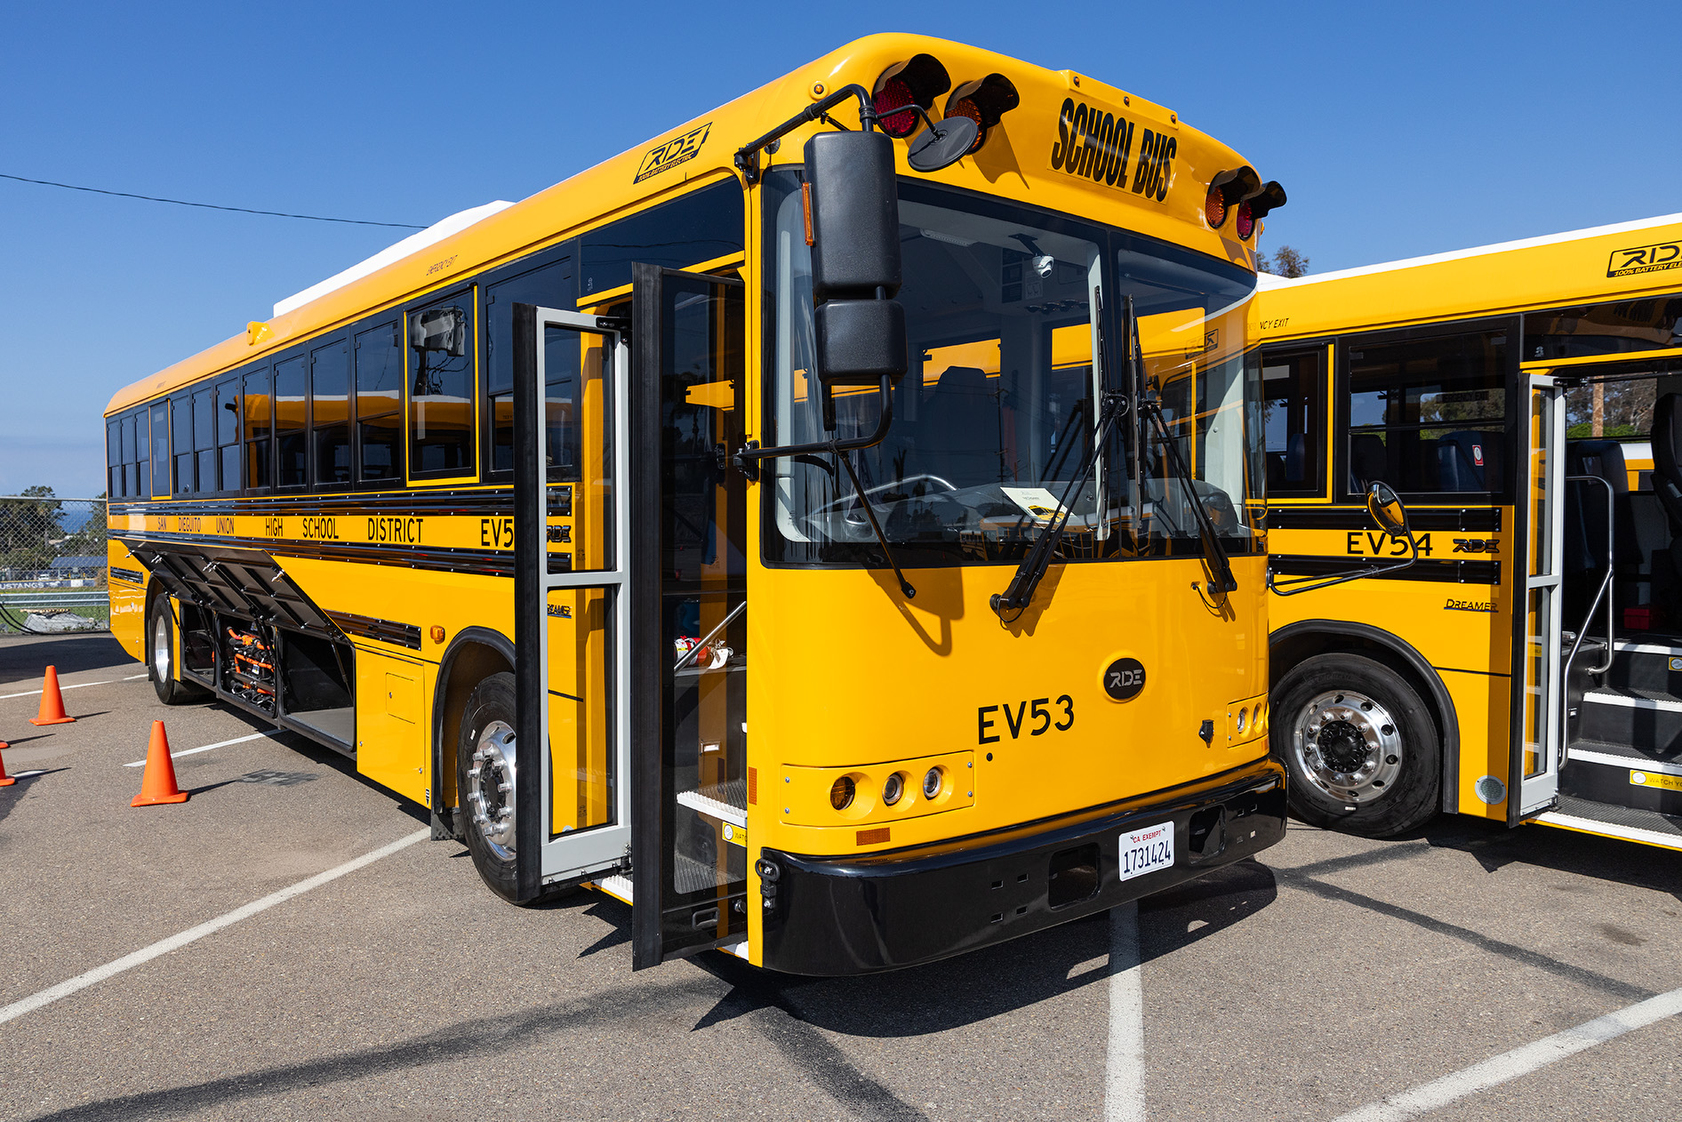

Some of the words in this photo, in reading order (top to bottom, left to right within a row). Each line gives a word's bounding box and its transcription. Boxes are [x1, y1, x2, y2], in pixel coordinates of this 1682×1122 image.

[644, 129, 703, 171] RIDE
[1051, 97, 1135, 189] SCHOOL
[1131, 128, 1177, 202] BUS
[1620, 245, 1682, 268] RID
[1273, 317, 1289, 329] EXIT
[157, 516, 167, 531] SAN
[216, 517, 235, 534] UNION
[265, 517, 284, 537] HIGH
[302, 517, 339, 540] SCHOOL
[367, 518, 424, 543] DISTRICT
[481, 518, 514, 548] EV5
[1346, 532, 1433, 557] EV54
[1452, 538, 1500, 553] RIDE
[0, 582, 44, 590] USTANGS
[546, 603, 572, 616] REAMER
[1446, 598, 1498, 612] DREAMER
[1109, 669, 1143, 689] RIDE
[978, 694, 1074, 745] EV53
[1132, 836, 1141, 844] CA
[1142, 830, 1162, 842] EXEMPT
[1123, 840, 1171, 874] 1731424
